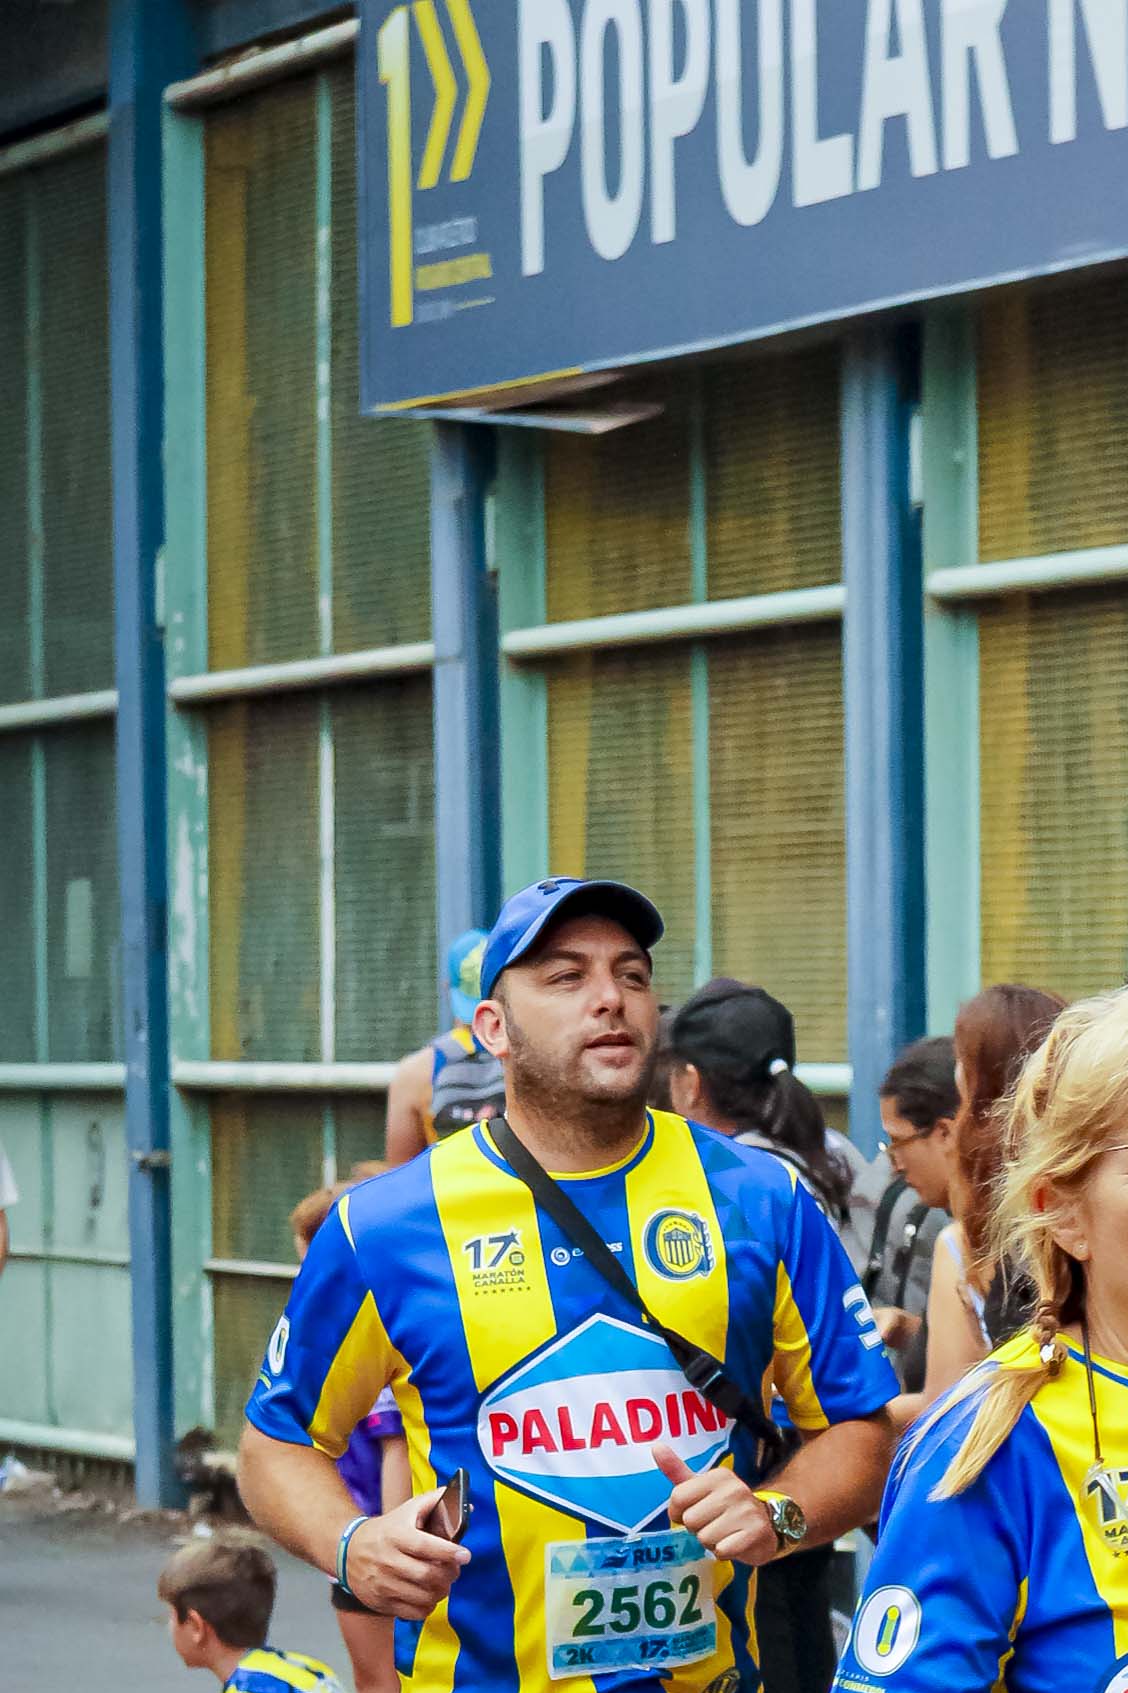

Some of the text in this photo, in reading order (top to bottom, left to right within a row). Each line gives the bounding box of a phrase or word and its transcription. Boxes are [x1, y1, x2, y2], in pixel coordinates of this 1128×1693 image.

[473, 1276, 526, 1288] CANALLA
[633, 1546, 675, 1564] RUS
[572, 1575, 702, 1637] 2562
[566, 1648, 595, 1666] 2K
